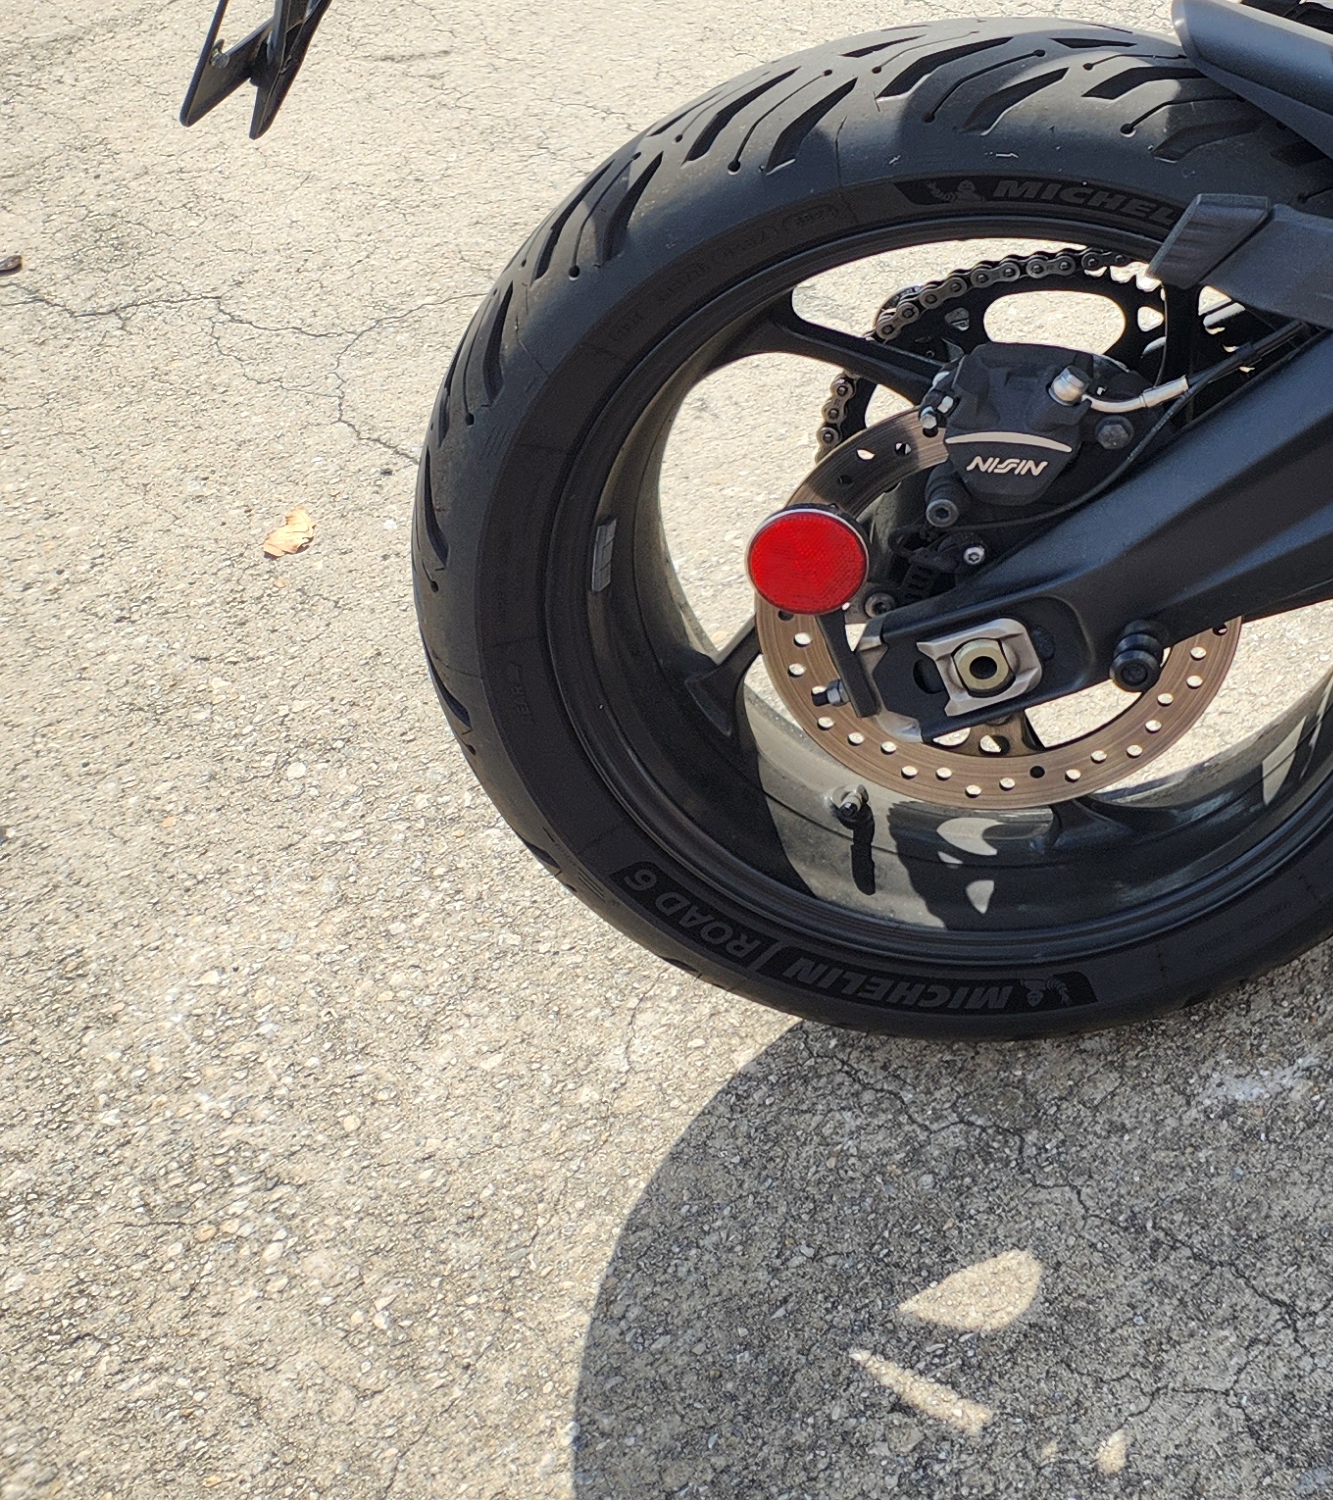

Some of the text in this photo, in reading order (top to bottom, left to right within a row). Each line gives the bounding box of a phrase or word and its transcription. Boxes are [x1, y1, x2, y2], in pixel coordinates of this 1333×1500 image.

[994, 181, 1177, 224] MICHEL
[966, 455, 1048, 476] NISSIN
[624, 867, 1013, 1011] MICHELIN ROAD 6
